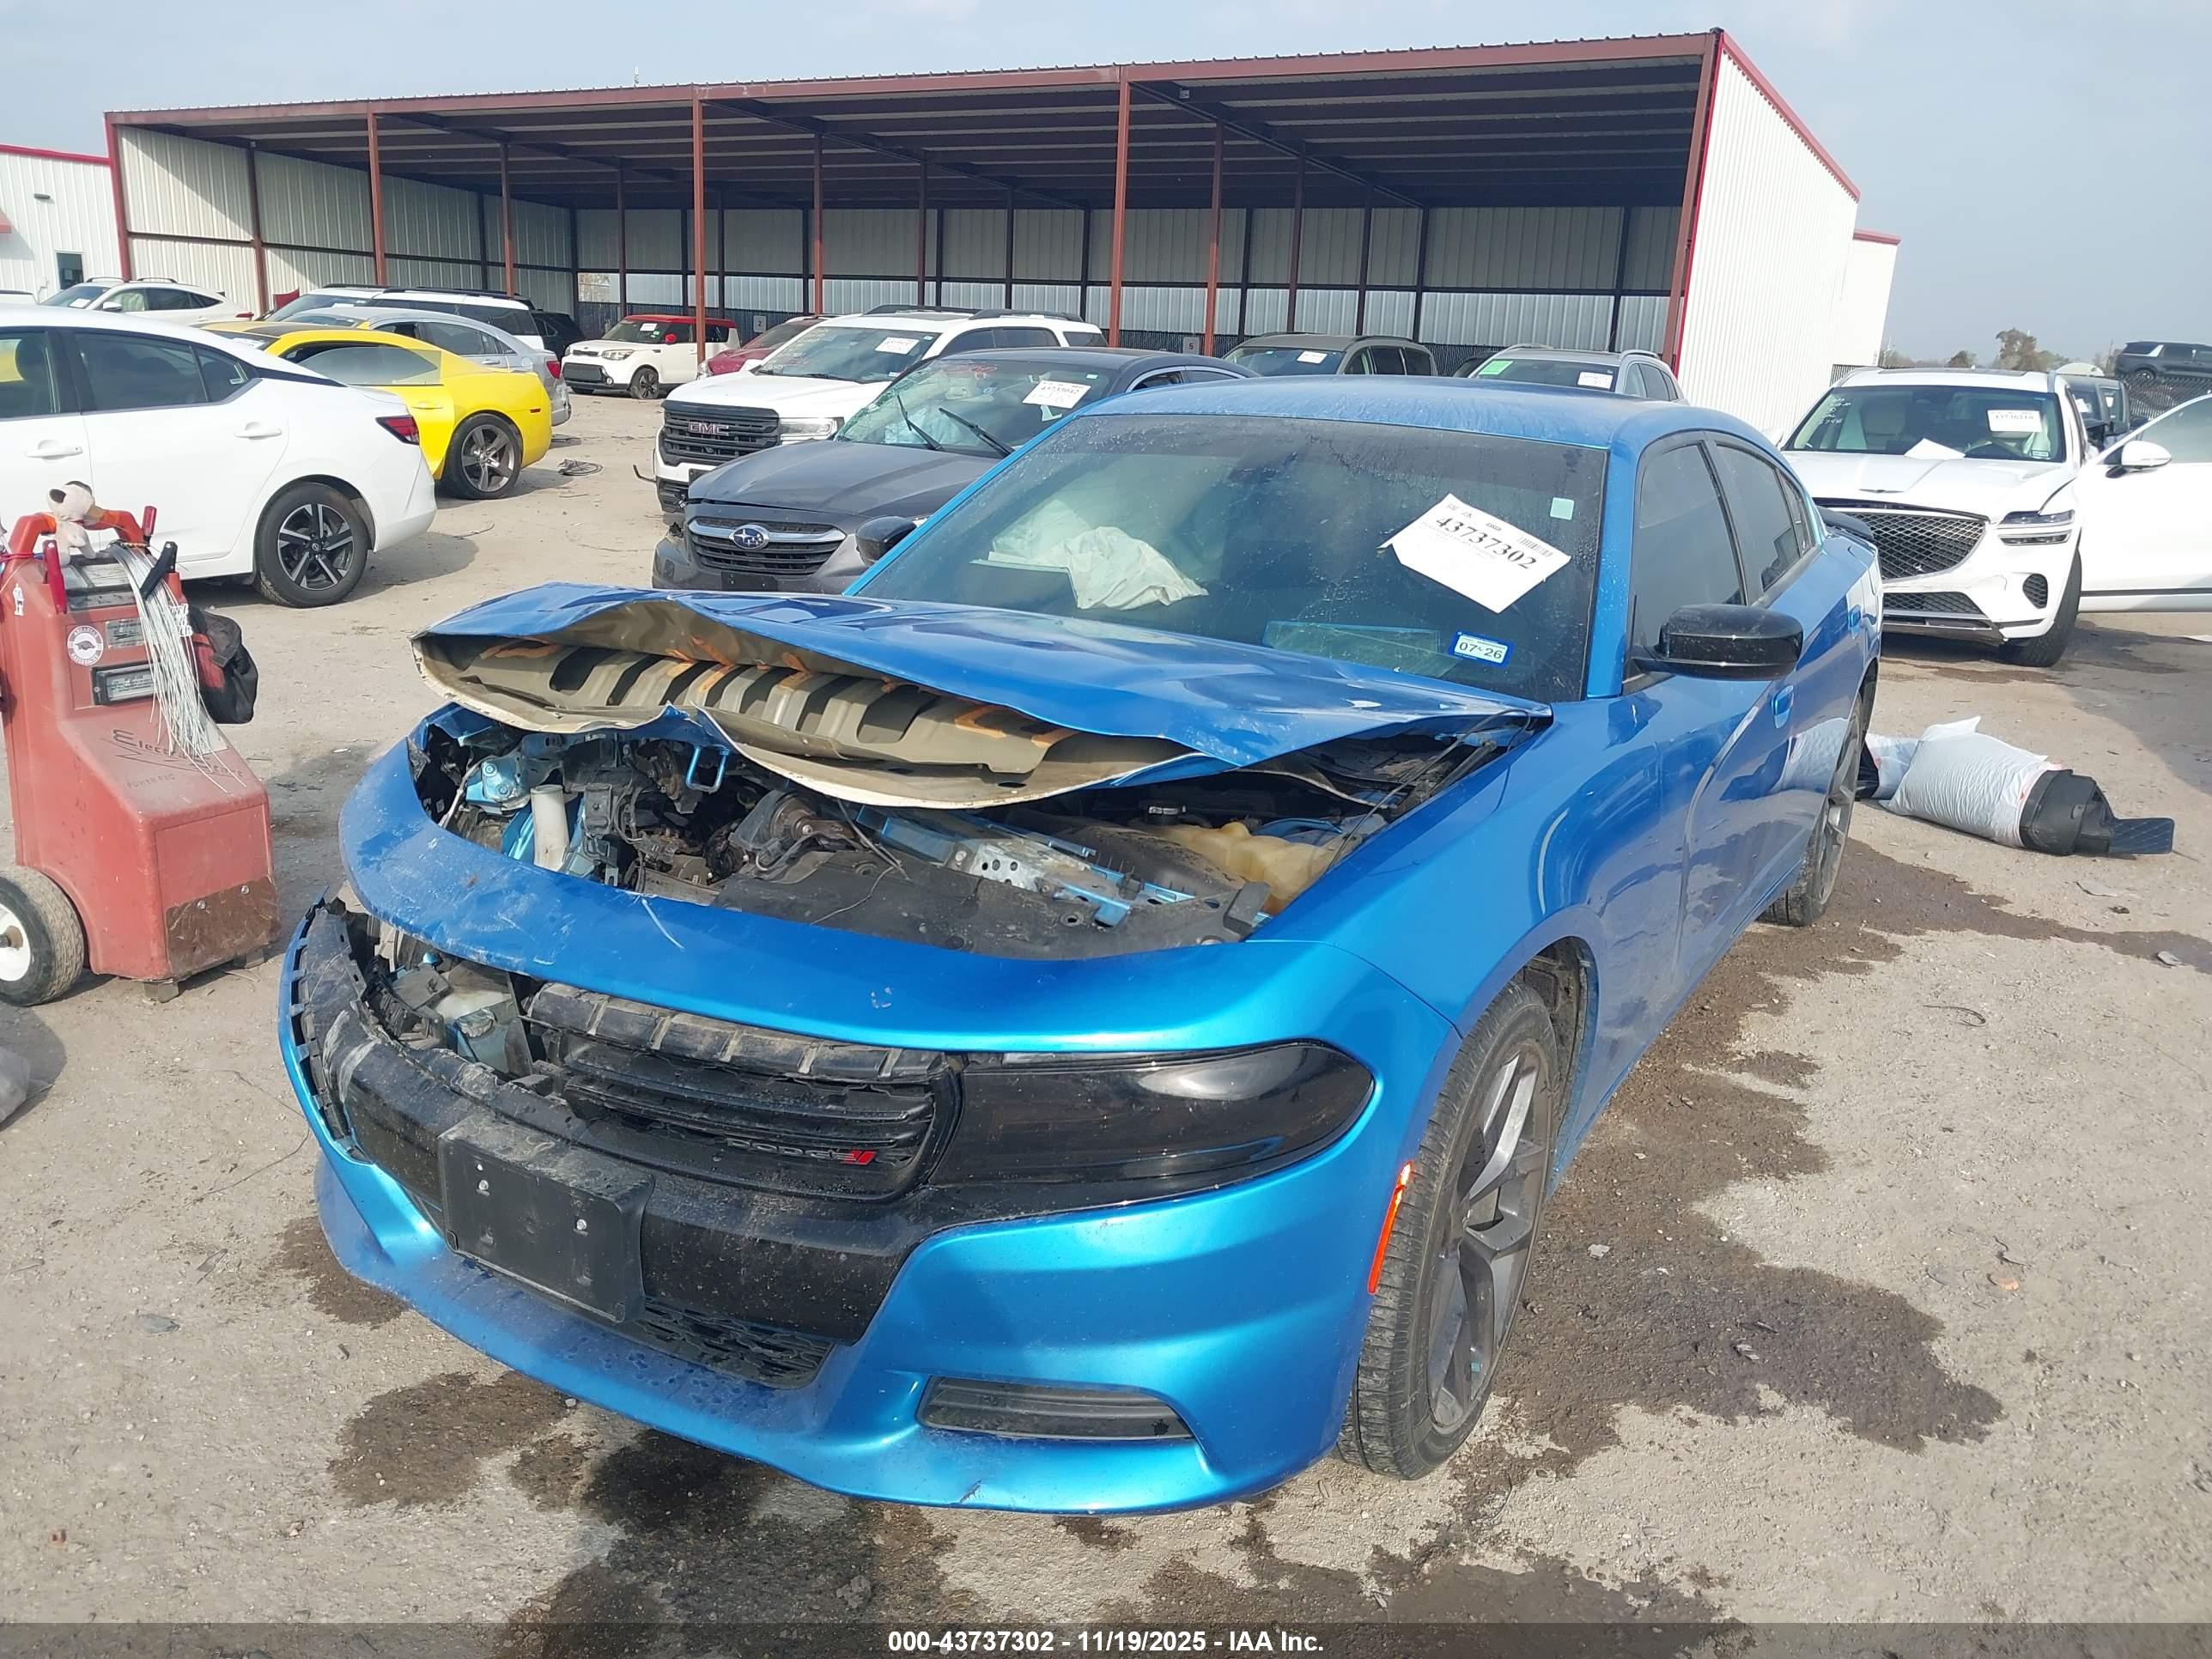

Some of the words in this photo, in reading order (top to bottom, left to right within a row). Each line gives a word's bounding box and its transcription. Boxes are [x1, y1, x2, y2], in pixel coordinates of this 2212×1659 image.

[689, 422, 729, 436] GMC
[1436, 518, 1537, 568] 43737302
[1460, 642, 1478, 652] 07
[1484, 648, 1503, 659] 26
[727, 1138, 858, 1161] DODGE
